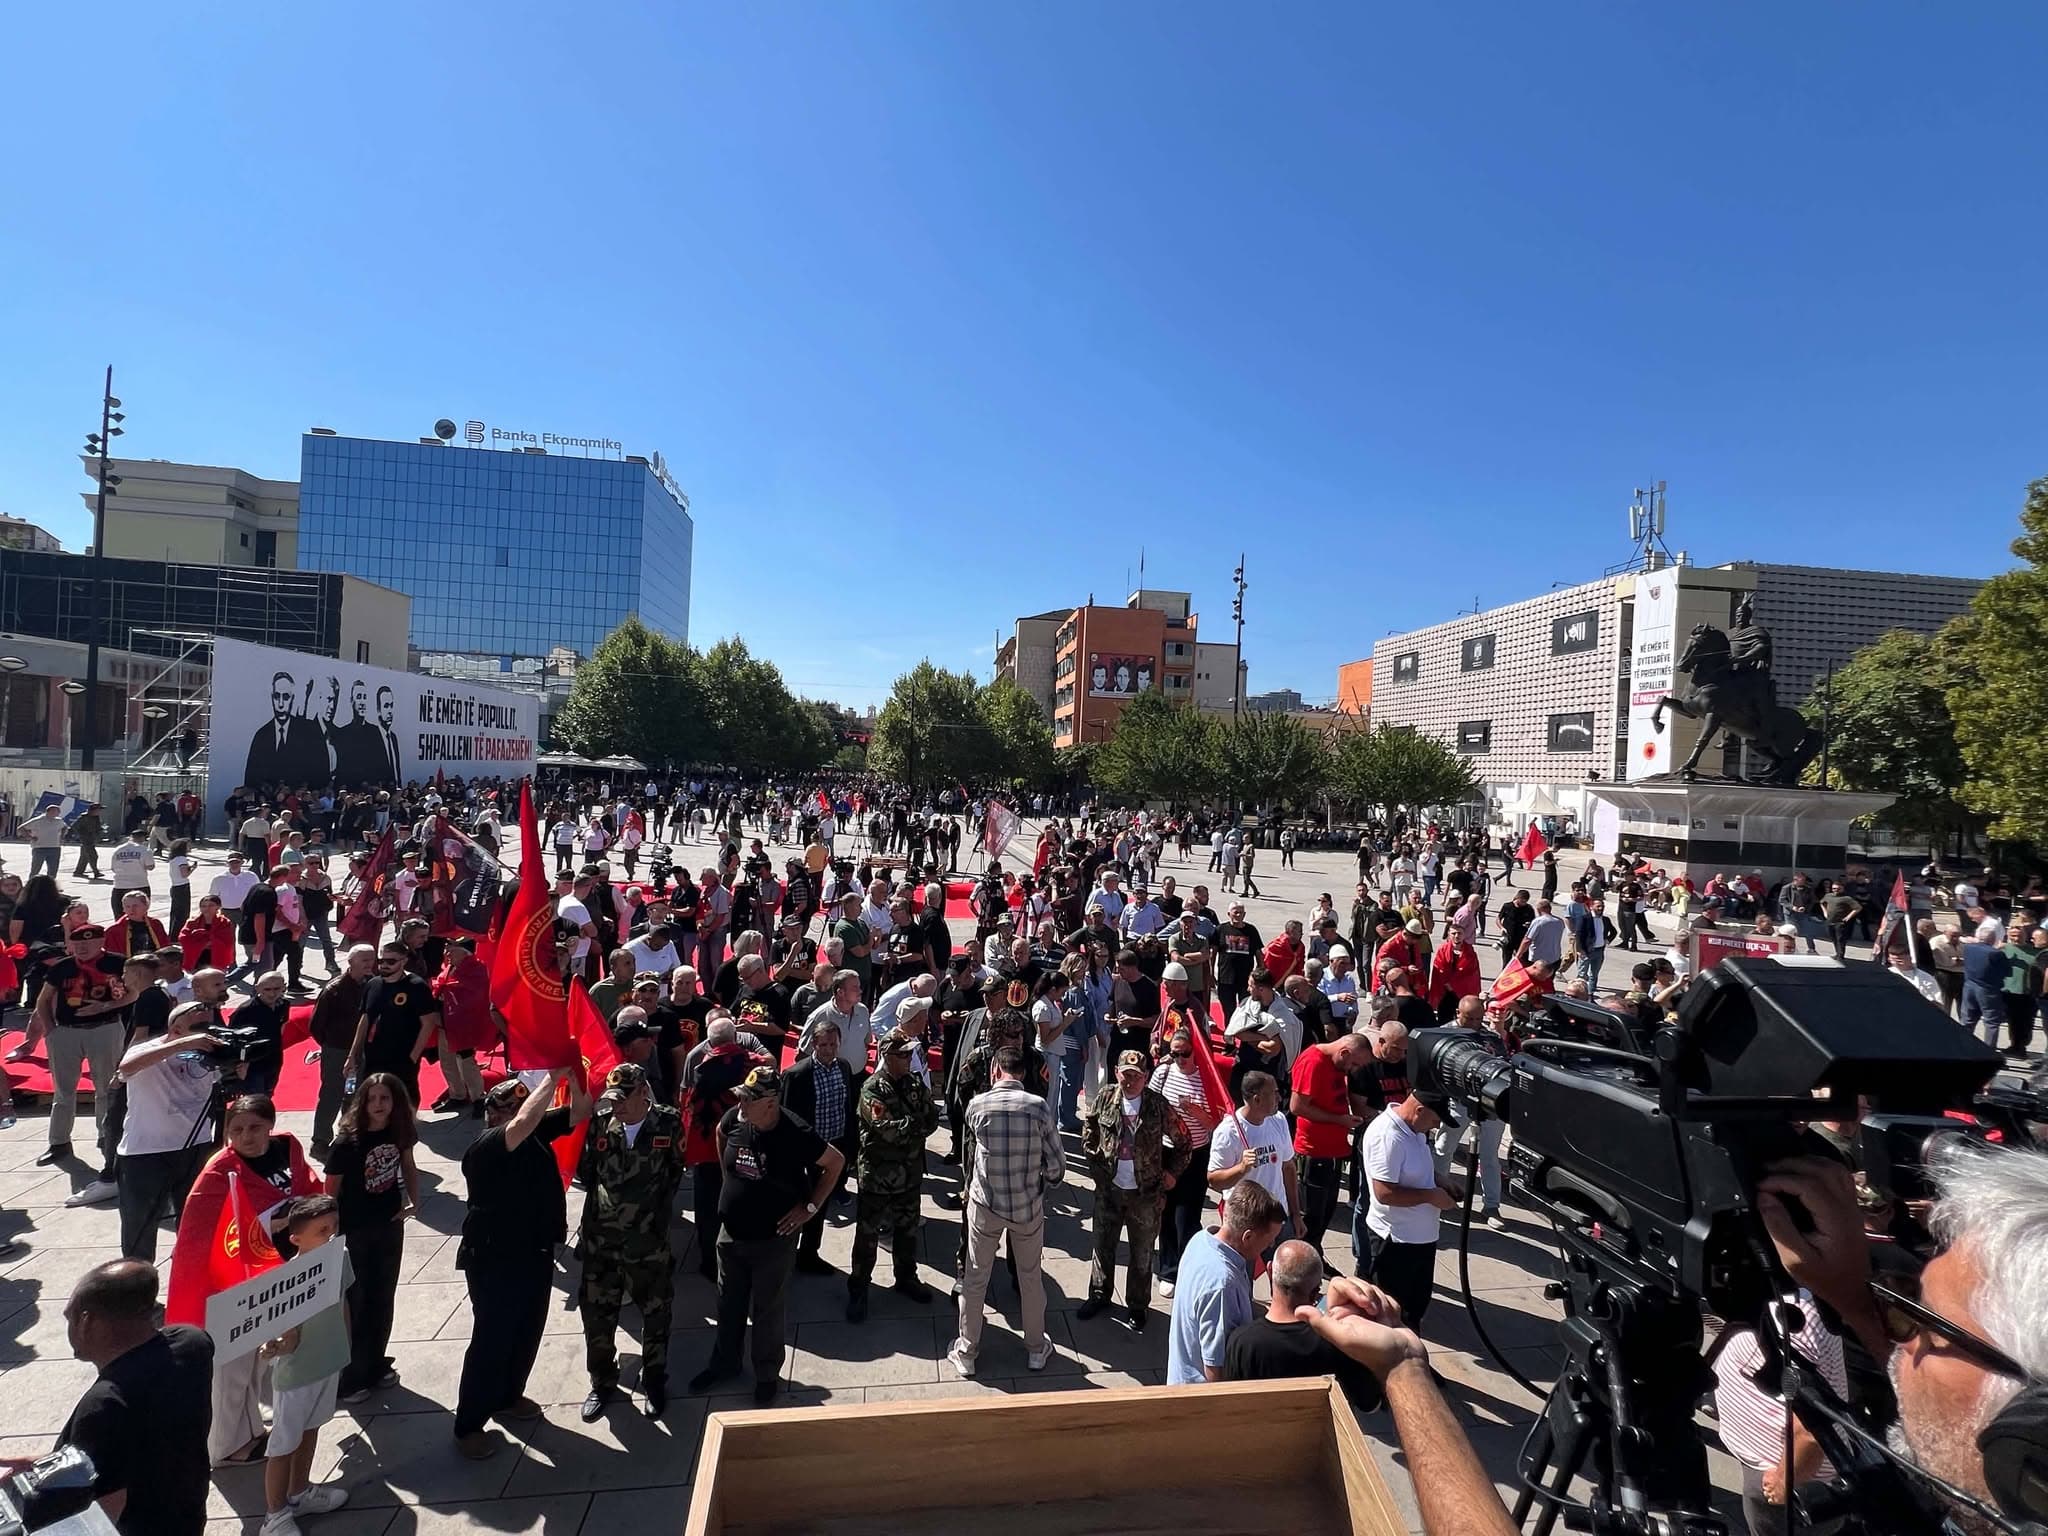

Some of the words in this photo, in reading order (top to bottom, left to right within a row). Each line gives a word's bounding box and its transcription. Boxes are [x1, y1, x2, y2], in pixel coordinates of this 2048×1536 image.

[491, 428, 537, 443] Banka
[542, 433, 622, 450] Ekonomike
[419, 689, 434, 722] NË
[435, 693, 463, 725] EMËR
[464, 696, 475, 726] TË
[418, 733, 472, 761] SHPALLENI
[474, 732, 484, 761] TË
[229, 1314, 263, 1344] për
